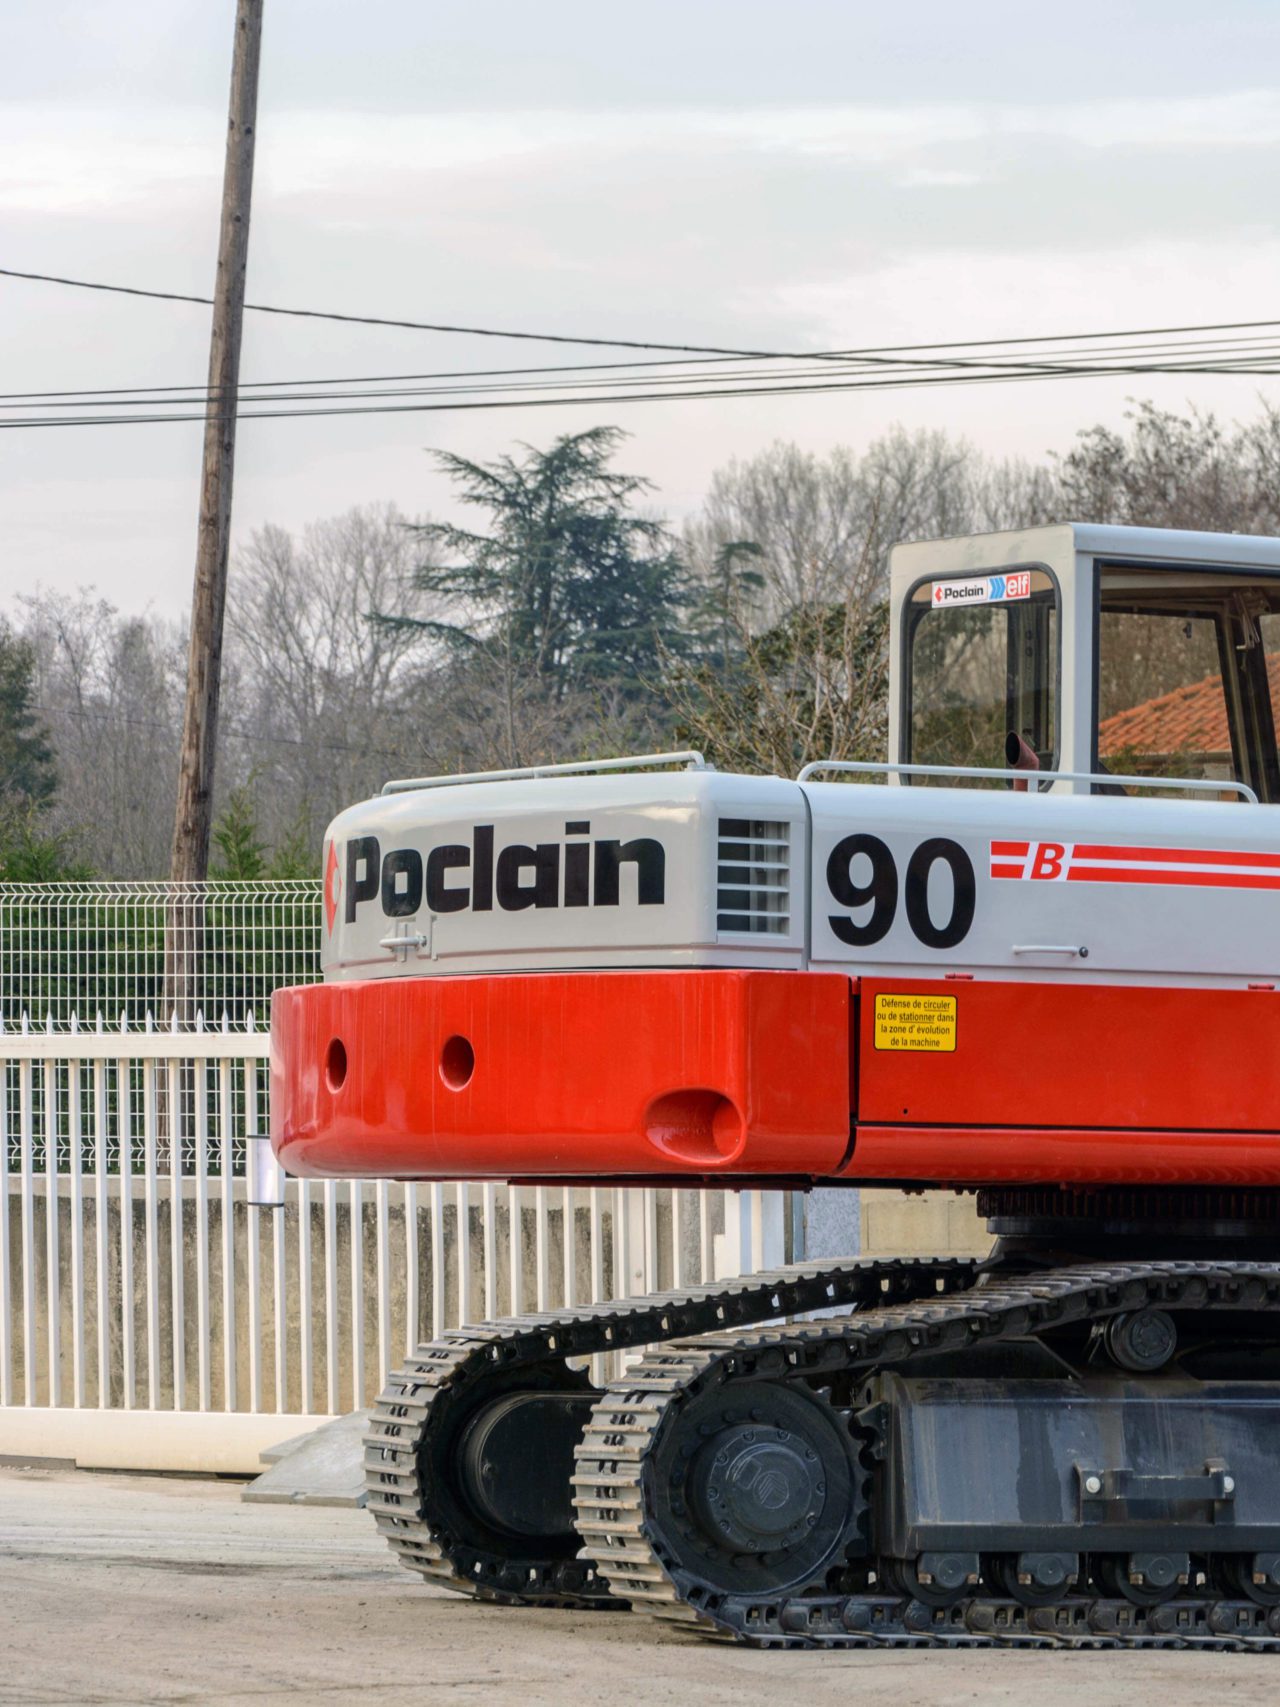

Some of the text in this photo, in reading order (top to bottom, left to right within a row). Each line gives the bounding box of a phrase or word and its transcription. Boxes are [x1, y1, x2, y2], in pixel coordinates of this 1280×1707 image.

[944, 575, 1029, 599] Poclain elf
[345, 821, 666, 924] Poclain
[826, 833, 1066, 950] 90 B
[881, 998, 951, 1010] Défense de circuler
[877, 1011, 954, 1022] ou de stationner dans
[881, 1024, 888, 1033] la
[889, 1025, 907, 1033] zone
[917, 1025, 950, 1035] évolution
[890, 1037, 941, 1047] de la machine
